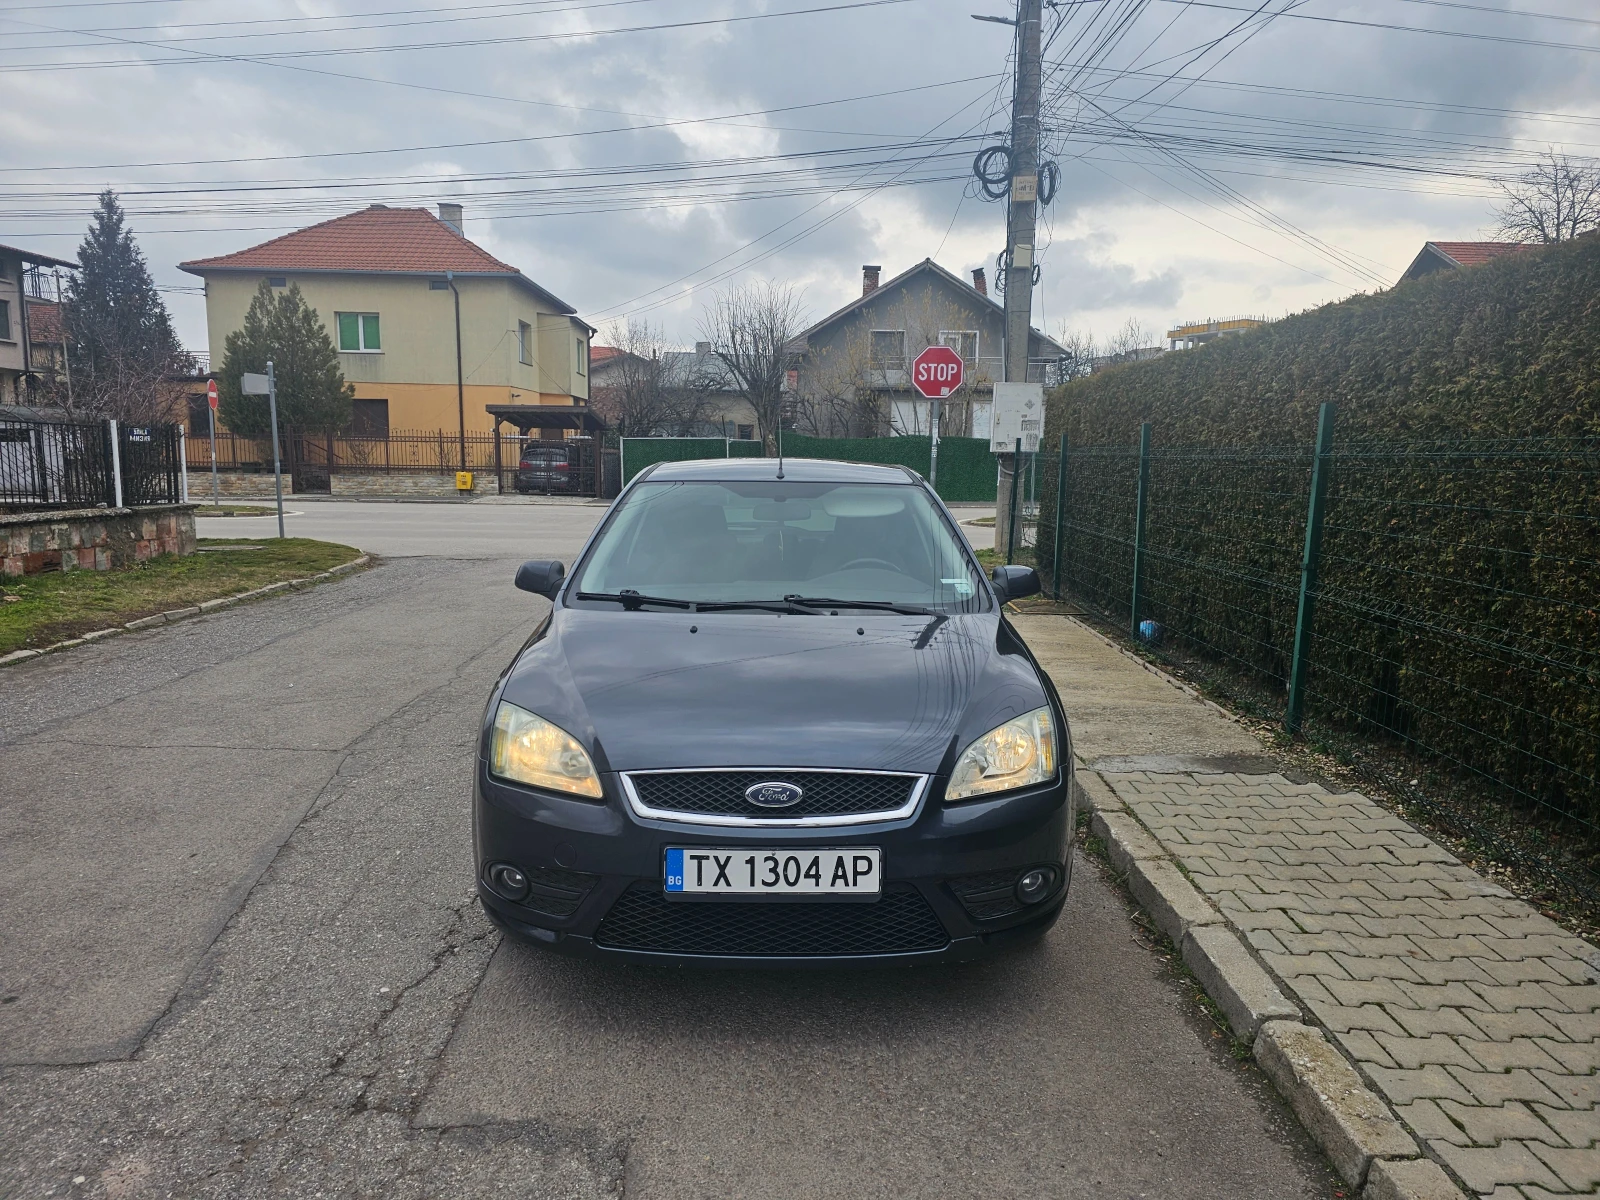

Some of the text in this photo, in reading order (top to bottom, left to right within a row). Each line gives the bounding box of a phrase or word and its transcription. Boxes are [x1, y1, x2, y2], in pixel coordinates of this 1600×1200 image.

[918, 363, 958, 381] STOP
[758, 787, 790, 801] Ford
[689, 854, 873, 887] TX 1304 AP
[668, 874, 682, 885] BG
